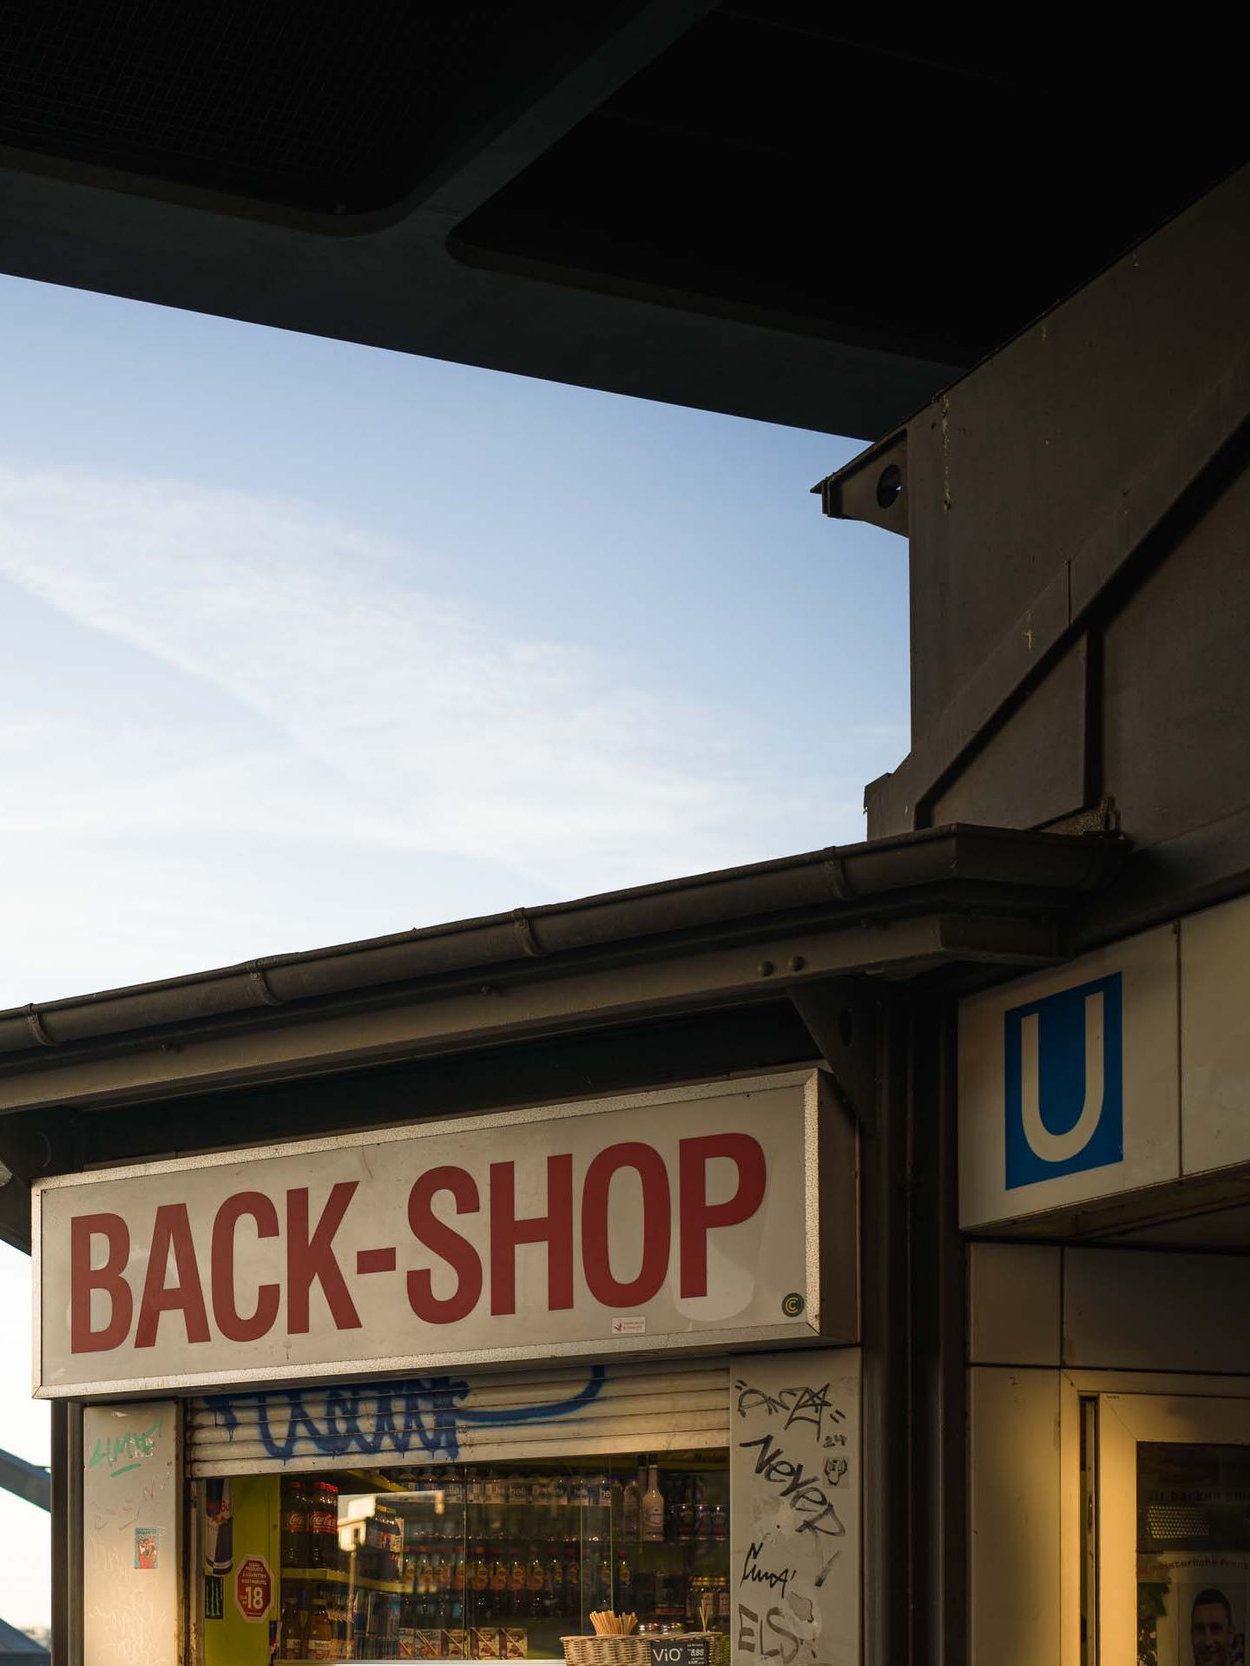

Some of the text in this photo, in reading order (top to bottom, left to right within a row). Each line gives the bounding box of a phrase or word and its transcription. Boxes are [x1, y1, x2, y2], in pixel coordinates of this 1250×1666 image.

[1020, 991, 1105, 1163] U
[70, 1132, 768, 1355] BACK-SHOP
[245, 1586, 263, 1610] 18
